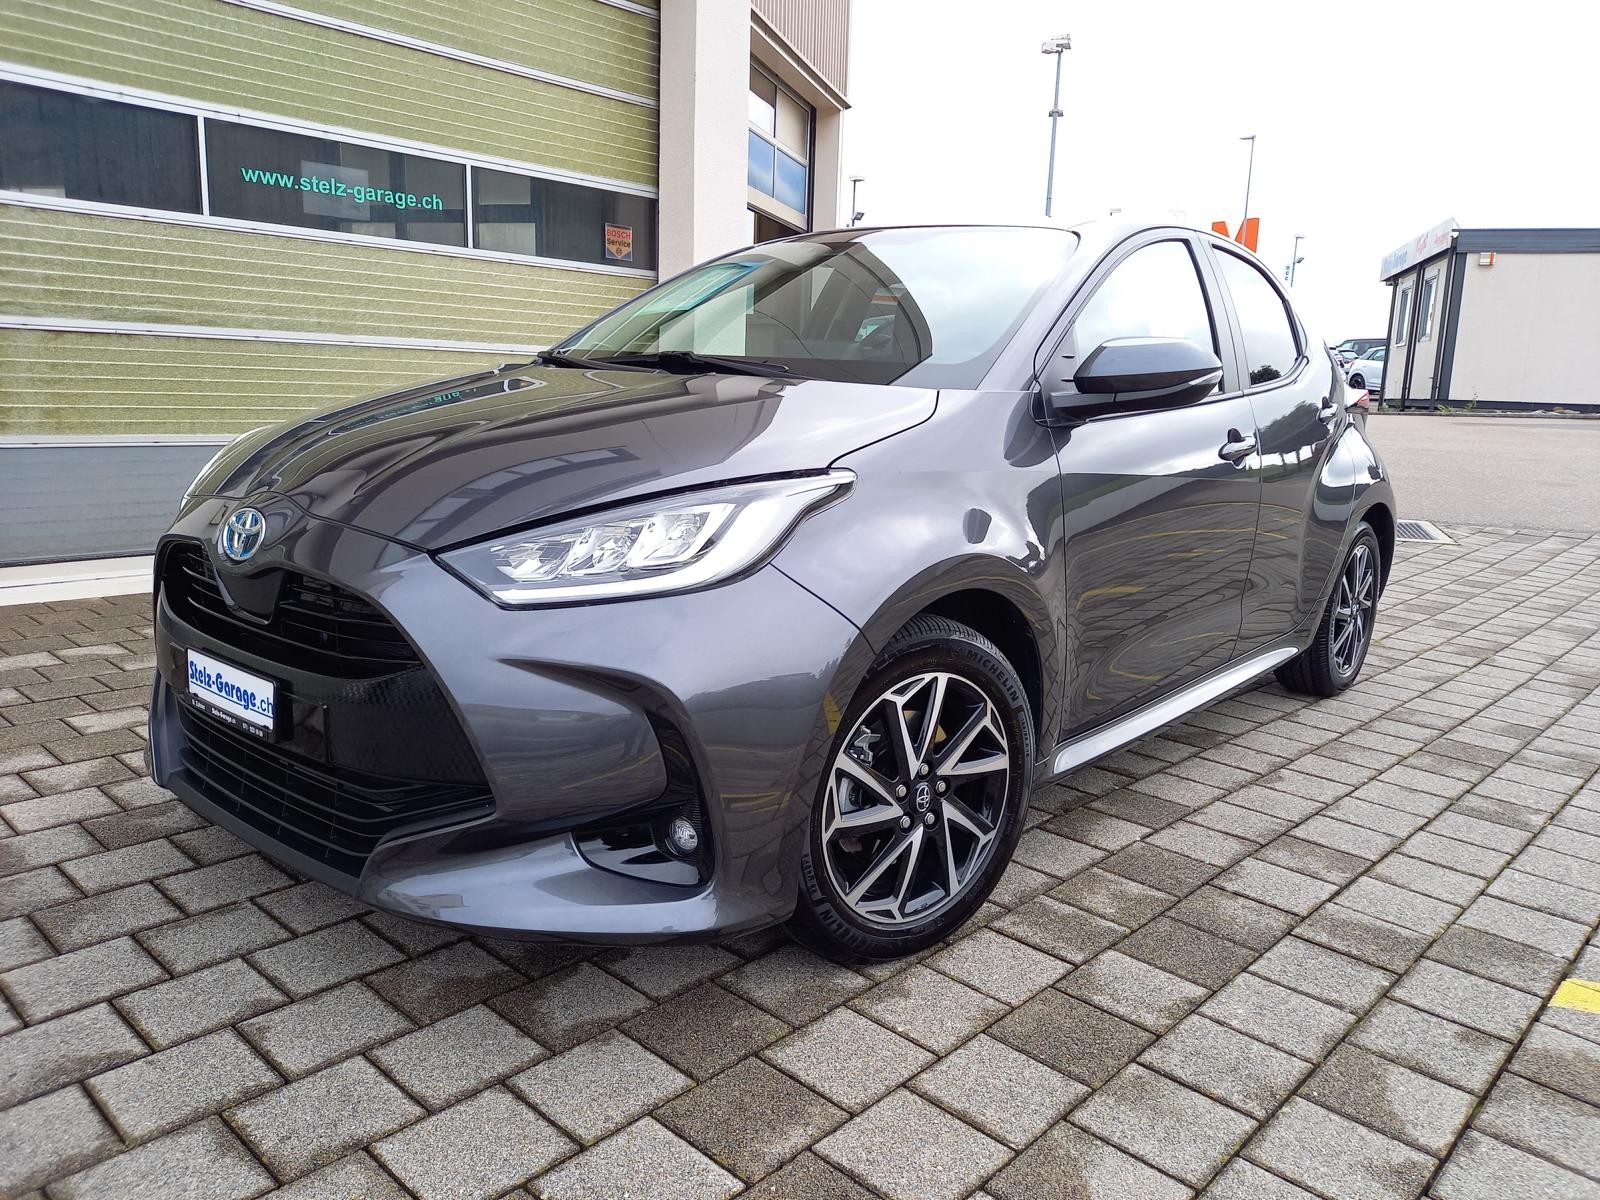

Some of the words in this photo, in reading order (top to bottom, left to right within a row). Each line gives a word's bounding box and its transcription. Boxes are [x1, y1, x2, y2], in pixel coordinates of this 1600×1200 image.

[241, 167, 443, 210] www.stelz-garage.ch
[607, 229, 631, 240] BOSCH
[607, 238, 631, 248] Service
[190, 660, 273, 715] Stelz-Garage.ch
[966, 650, 1019, 702] MICHELIN
